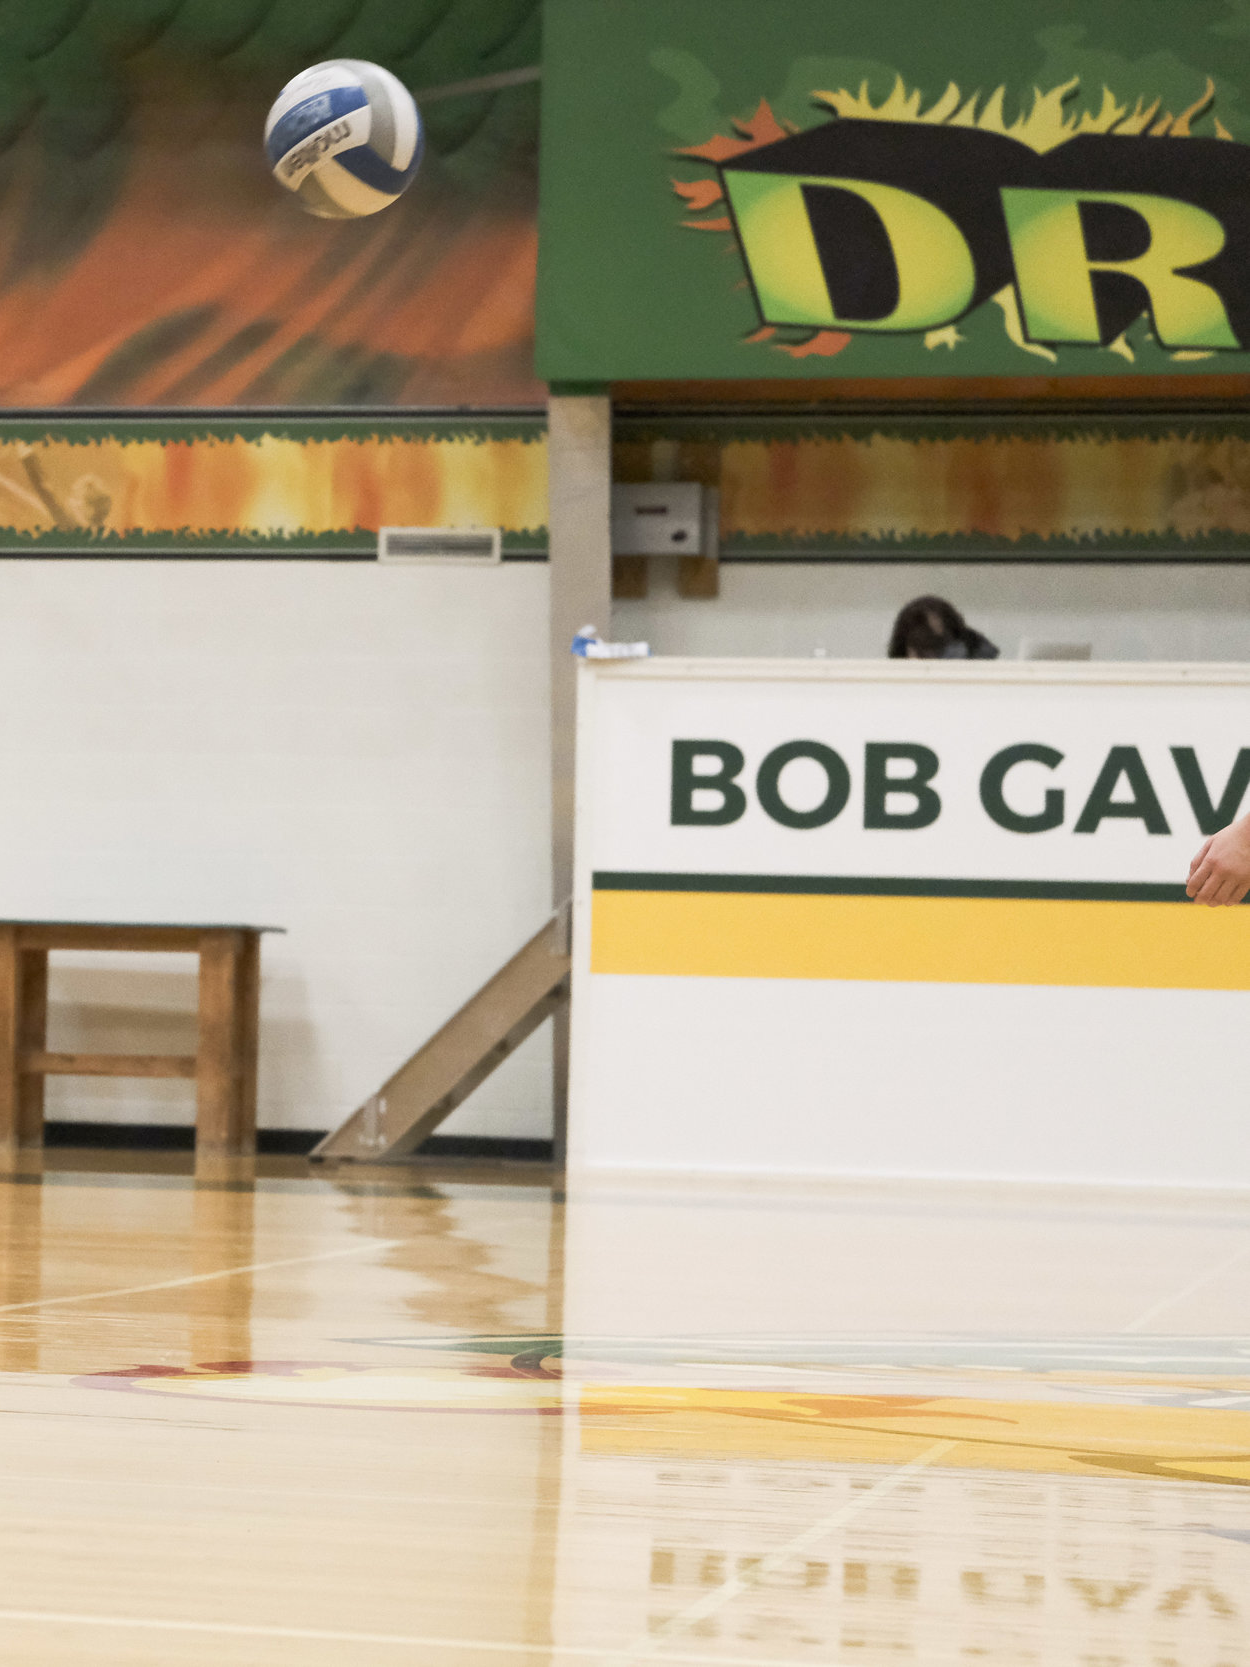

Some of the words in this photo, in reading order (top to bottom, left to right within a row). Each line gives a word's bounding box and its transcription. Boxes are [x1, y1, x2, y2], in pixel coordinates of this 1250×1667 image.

[719, 167, 1244, 350] DR
[669, 738, 942, 830] BOB
[978, 742, 1250, 836] GAV
